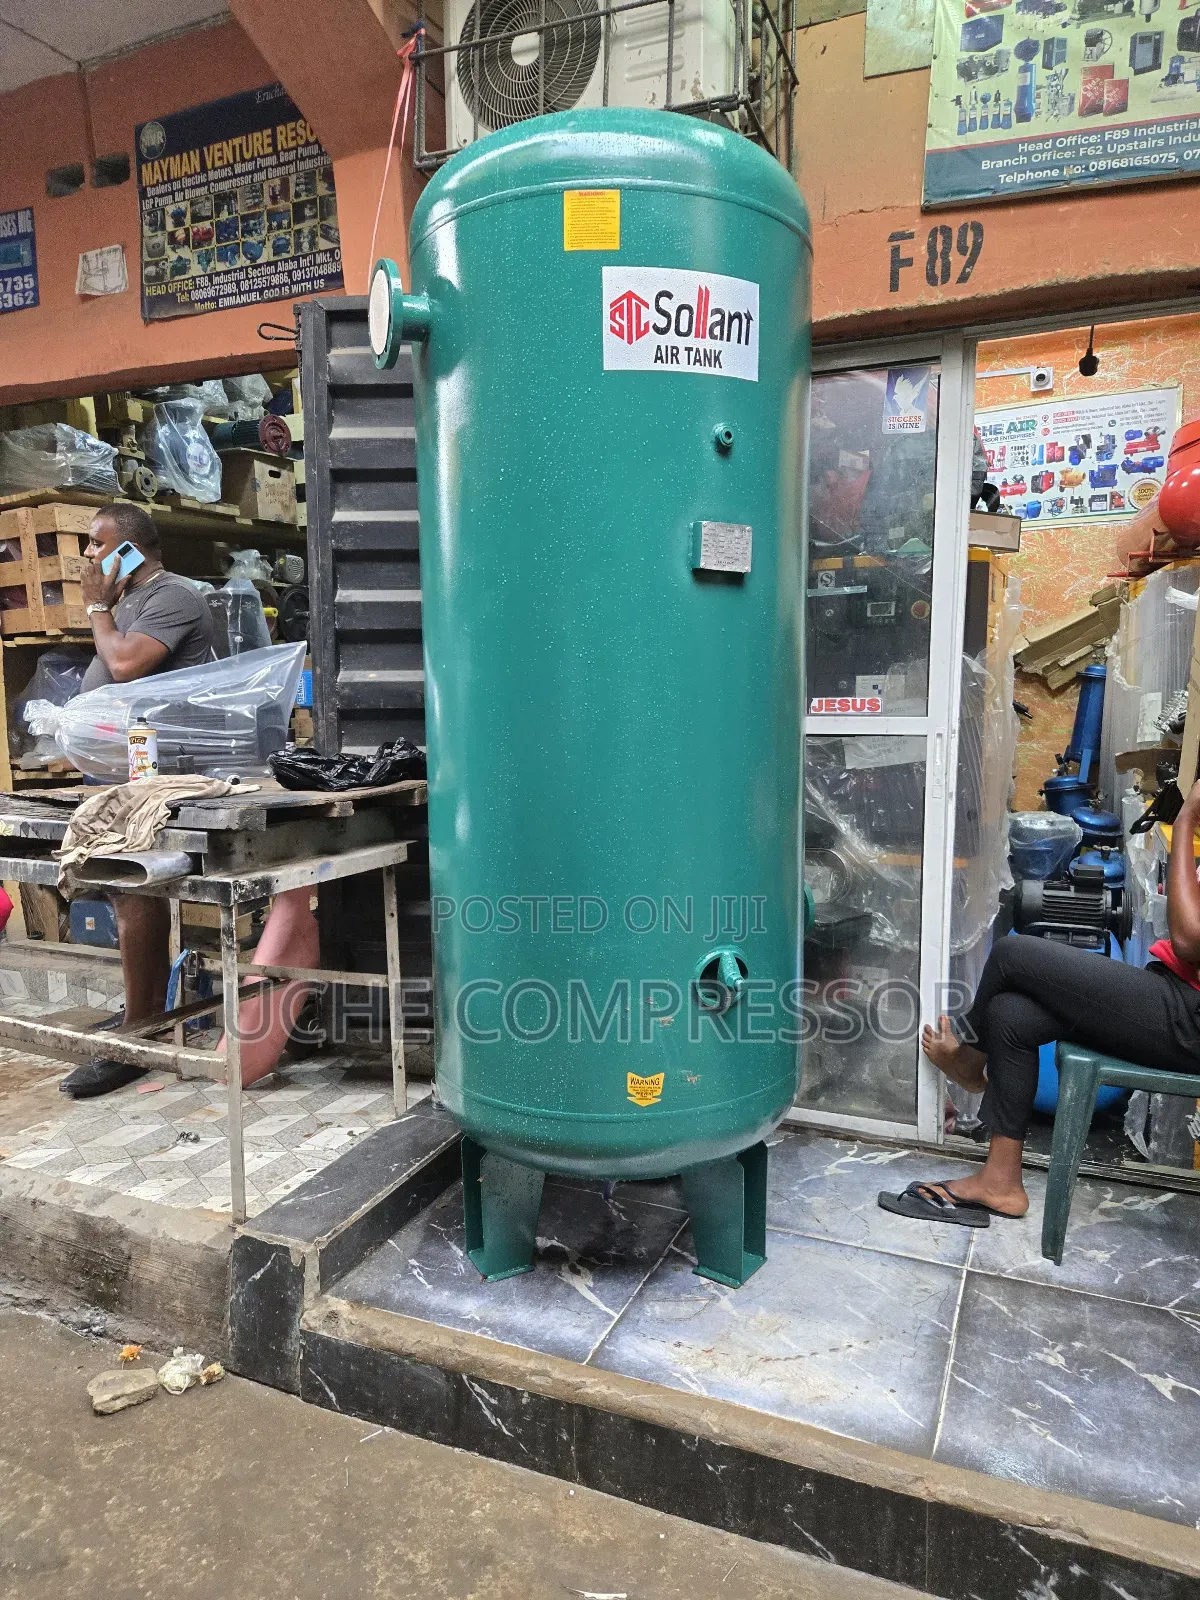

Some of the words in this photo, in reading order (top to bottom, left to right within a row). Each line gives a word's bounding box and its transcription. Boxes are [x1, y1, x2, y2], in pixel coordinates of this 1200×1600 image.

[981, 155, 1028, 170] Branch
[1031, 148, 1076, 163] Office:
[1079, 144, 1103, 156] F62
[1107, 138, 1164, 154] Upstairs
[1018, 141, 1052, 153] Head
[1056, 133, 1101, 148] Office:
[1104, 128, 1130, 141] F89
[141, 148, 201, 187] MAYMAN
[203, 128, 273, 170] VENTURE
[999, 167, 1060, 184] Telphone
[1089, 154, 1179, 172] 08168165075,
[147, 183, 172, 197] Dealers
[182, 172, 207, 188] Electric
[208, 166, 234, 182] Motors,
[234, 160, 256, 175] Water
[280, 149, 297, 162] Gear
[174, 190, 184, 203] Air
[210, 173, 253, 194] Compressor
[253, 170, 267, 183] and
[267, 161, 296, 178] General
[146, 284, 167, 296] HEAD
[168, 279, 195, 294] OFFICE:
[196, 275, 212, 288] F88,
[212, 267, 246, 285] Industrial
[247, 264, 276, 278] Section
[277, 260, 298, 273] Alaba
[176, 292, 190, 304] Tel:
[194, 301, 217, 312] Motto:
[218, 291, 262, 308] EMMANUEL
[263, 288, 280, 299] GOD
[281, 285, 290, 296] IS
[291, 280, 312, 294] WITH
[313, 278, 325, 290] US
[652, 284, 755, 346] Sollant
[653, 344, 681, 365] AIR
[684, 346, 723, 369] TANK
[887, 415, 922, 423] SUCCESS
[1006, 419, 1038, 433] AIR
[811, 698, 881, 712] JESUS
[630, 1077, 660, 1085] WARNING
